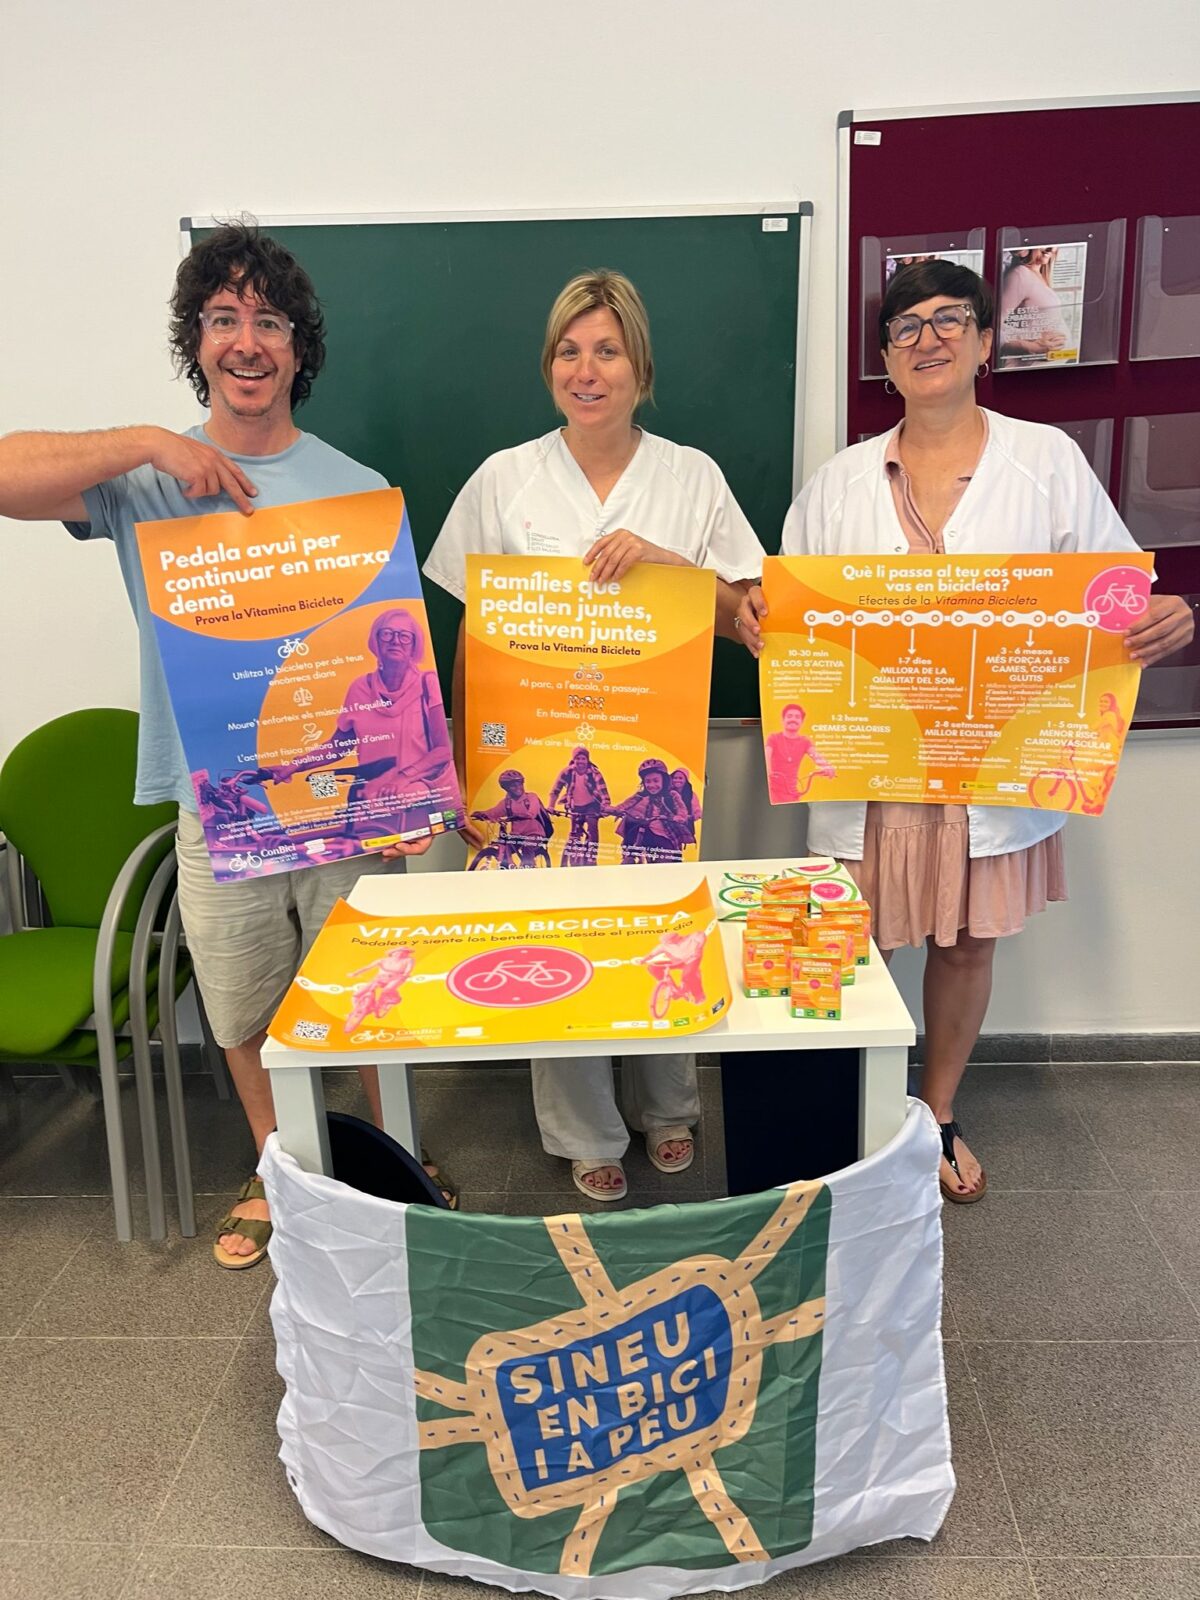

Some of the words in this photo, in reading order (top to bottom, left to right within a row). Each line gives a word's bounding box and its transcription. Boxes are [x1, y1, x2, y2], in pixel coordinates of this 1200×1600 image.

[160, 542, 241, 571] Pedala
[246, 534, 297, 557] avui
[302, 532, 341, 557] per
[165, 564, 275, 593] continuar
[281, 561, 309, 576] en
[314, 549, 391, 572] marxa
[842, 564, 873, 580] Què
[877, 563, 886, 578] li
[889, 566, 933, 581] passa
[936, 564, 952, 578] al
[955, 565, 980, 578] teu
[983, 567, 1009, 578] cos
[1011, 566, 1054, 581] quan
[480, 569, 572, 593] Famílies
[578, 579, 621, 599] que
[885, 582, 912, 593] vas
[915, 582, 934, 593] en
[938, 578, 1010, 593] bicicleta?
[168, 588, 235, 616] demà
[858, 595, 900, 606] Efectes
[902, 595, 918, 606] de
[920, 595, 931, 606] la
[935, 595, 984, 606] Vitamina
[987, 595, 1038, 606] Bicicleta
[195, 611, 229, 626] Prova
[232, 609, 243, 622] la
[244, 602, 297, 620] Vitamina
[299, 596, 345, 612] Bicicleta
[480, 593, 572, 617] pedalen
[576, 598, 652, 624] juntes,
[486, 615, 584, 640] s'activen
[588, 621, 658, 647] juntes
[509, 640, 539, 652] Prova
[541, 641, 551, 652] la
[553, 642, 599, 655] Vitamina
[600, 644, 641, 657] Bicicleta
[788, 649, 812, 658] 10-30
[812, 649, 829, 658] min
[1000, 647, 1006, 656] 3
[1014, 647, 1021, 656] 6
[232, 668, 263, 681] Utilitza
[265, 667, 274, 676] la
[276, 660, 313, 675] bicicleta
[315, 658, 330, 670] per
[345, 653, 364, 664] teus
[771, 660, 781, 668] EL
[782, 659, 802, 668] COS
[803, 659, 845, 668] S'ACTIVA
[912, 656, 932, 666] dies
[985, 655, 1007, 665] MÉS
[1008, 656, 1042, 667] FORÇA
[1043, 656, 1051, 665] A
[1052, 656, 1071, 665] LES
[880, 666, 920, 675] MILLORA
[921, 667, 934, 675] DE
[935, 667, 948, 675] LA
[1030, 665, 1057, 674] CORE
[1058, 664, 1063, 673] I
[519, 678, 529, 687] Al
[872, 675, 915, 685] QUALITAT
[915, 675, 933, 685] DEL
[934, 676, 956, 685] SON
[1009, 674, 1044, 683] GLUTIS
[536, 708, 549, 719] En
[587, 710, 608, 722] amb
[924, 729, 958, 737] MILLOR
[1039, 729, 1074, 738] MENOR
[1074, 731, 1099, 741] RISC
[1024, 737, 1112, 751] CARDIOVASCULAR
[358, 922, 518, 939] VITAMINA
[527, 910, 692, 933] BICICLETA
[351, 936, 408, 947] Pedalea
[422, 936, 461, 945] siente
[467, 935, 484, 943] los
[490, 932, 561, 943] beneficios
[564, 930, 608, 938] desde
[626, 927, 669, 937] primer
[510, 1312, 691, 1404] SINEU
[536, 1394, 599, 1440] EN
[617, 1346, 717, 1419] BICI
[535, 1448, 549, 1480] I
[567, 1441, 594, 1473] A
[608, 1394, 697, 1458] PEU
